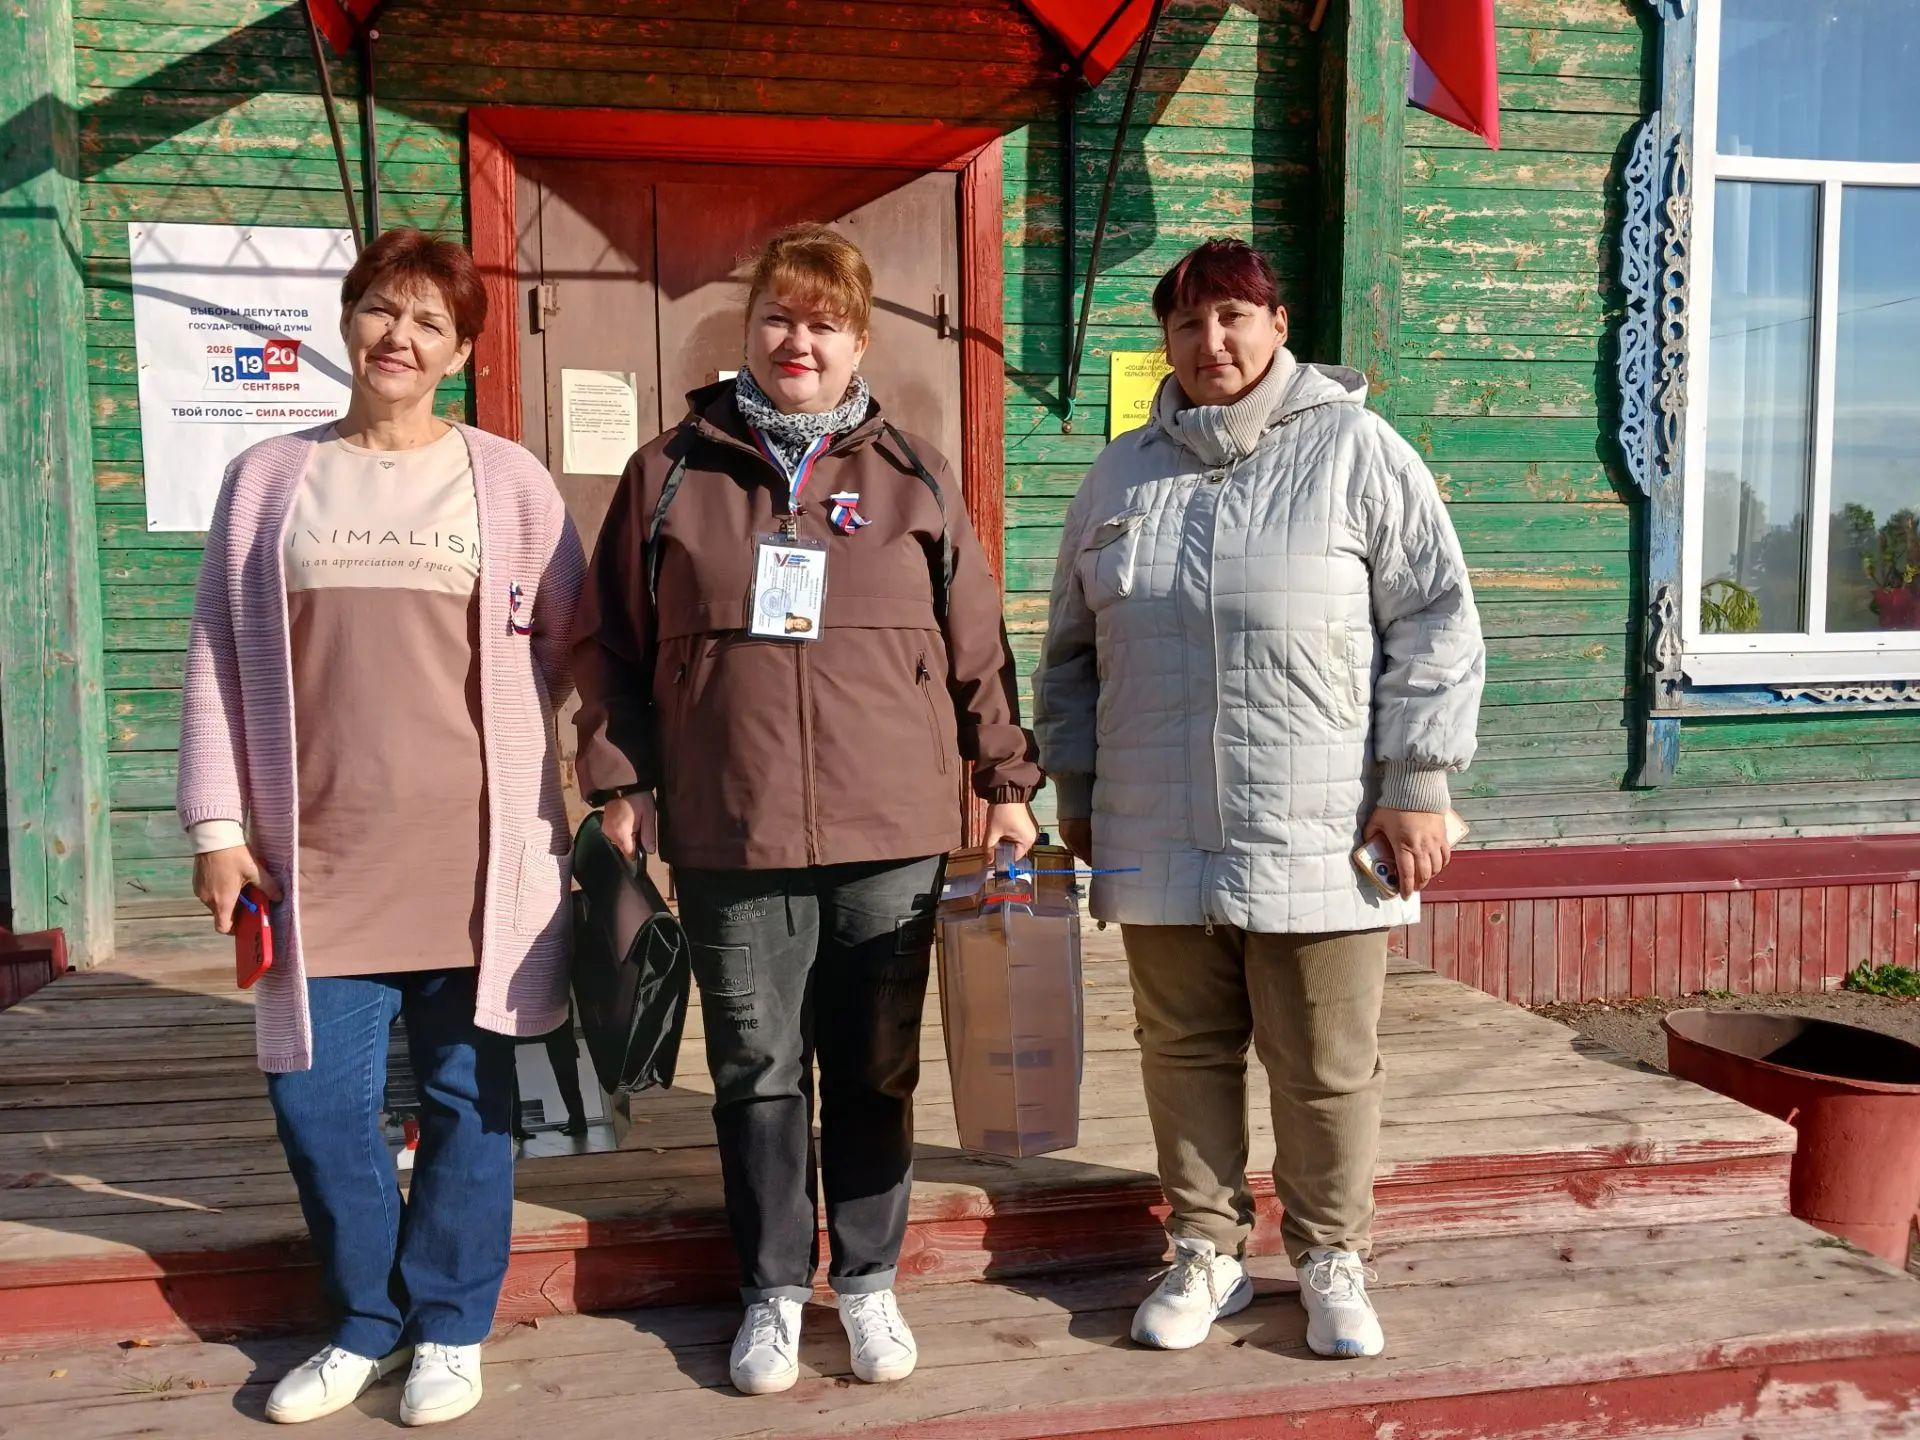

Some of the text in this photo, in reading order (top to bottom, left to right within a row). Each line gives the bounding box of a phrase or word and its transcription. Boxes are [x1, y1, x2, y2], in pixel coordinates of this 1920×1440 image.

[190, 307, 309, 318] ВЫБОРЫ ДЕПУТАТОВ
[188, 321, 312, 332] ГОСУДАРСТВЕННОЙ ДУМЫ
[206, 345, 233, 354] 2026
[211, 346, 296, 383] 18 19 20
[242, 382, 301, 392] СЕНТЯБРЯ
[171, 406, 202, 417] ТВОЙ
[205, 408, 243, 417] ГОЛОС
[255, 408, 287, 417] СИЛА
[289, 409, 338, 418] РОССИИ!
[302, 557, 454, 573] is an appreciation of space
